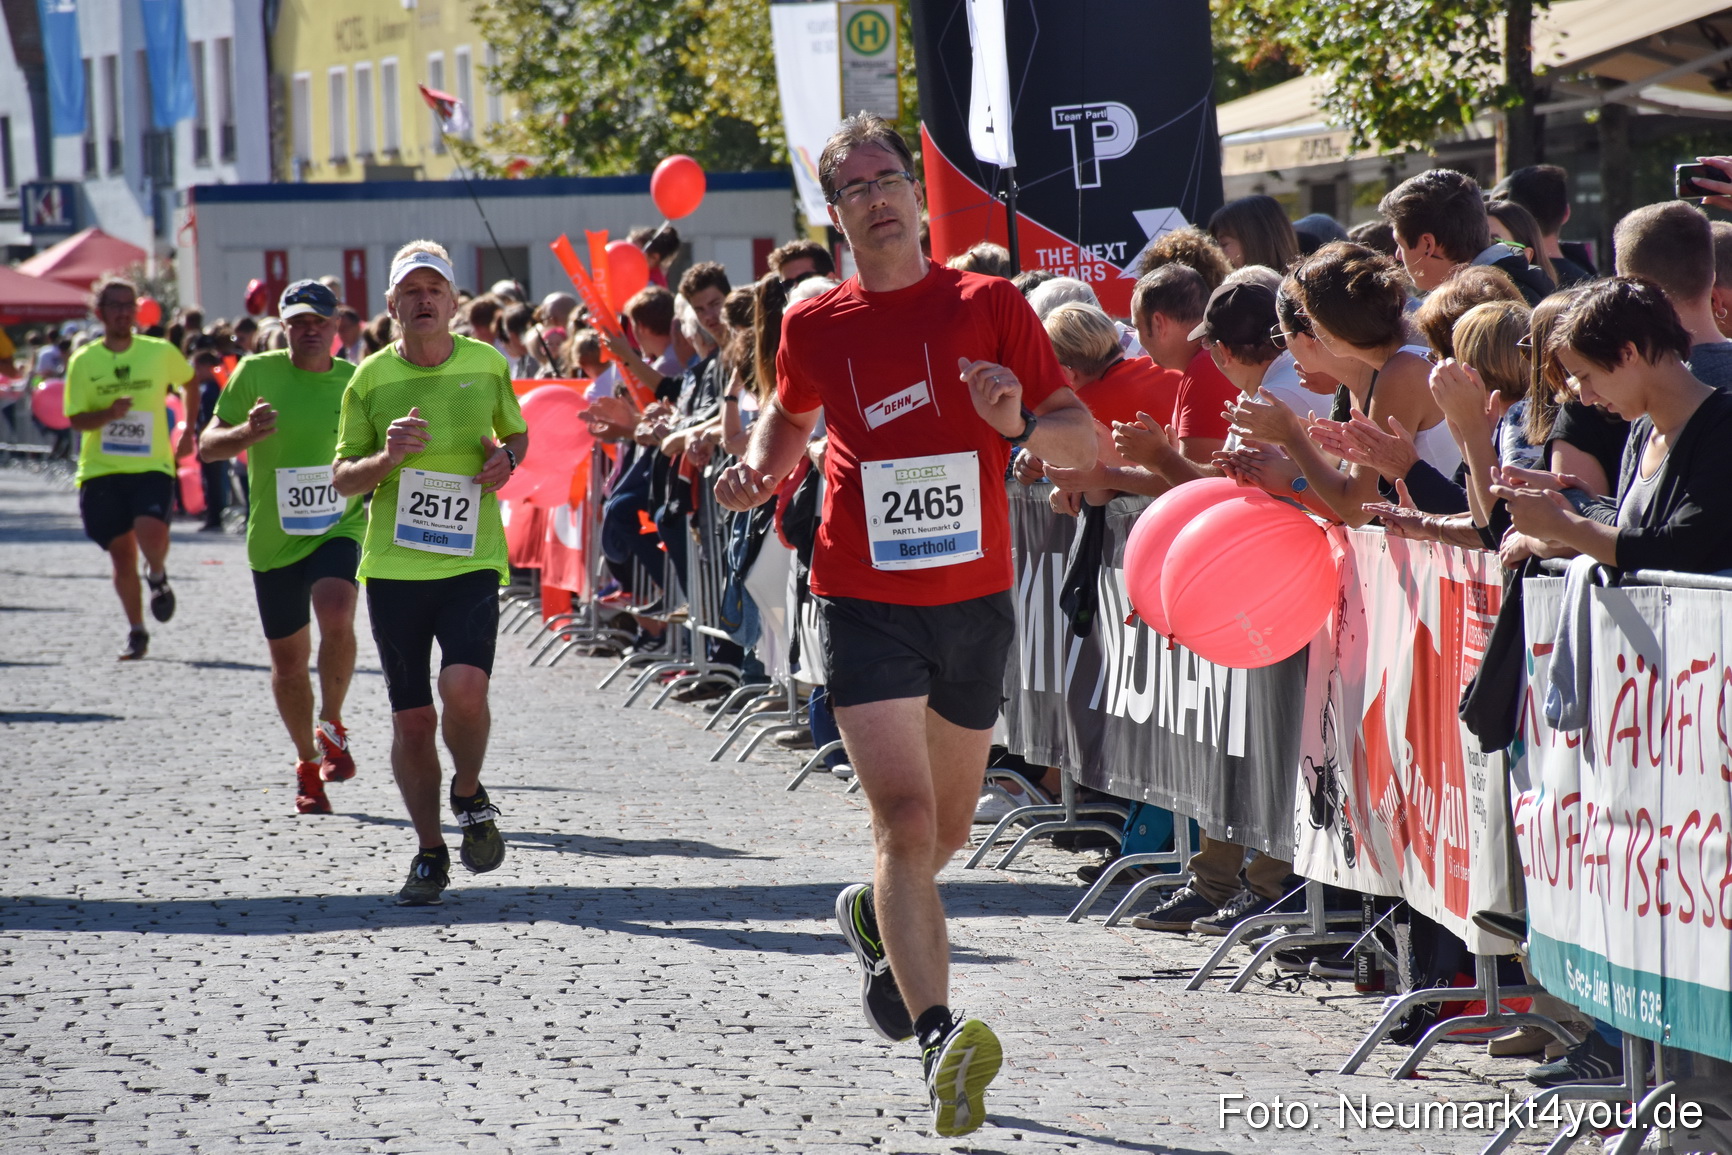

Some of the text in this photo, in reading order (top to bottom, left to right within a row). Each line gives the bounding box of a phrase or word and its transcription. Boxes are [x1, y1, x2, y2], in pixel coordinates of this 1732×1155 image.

[857, 20, 878, 45] H
[1036, 241, 1127, 267] THE NEXT
[884, 394, 912, 416] DEHN
[109, 422, 146, 438] 2296
[895, 464, 947, 481] BOCK
[424, 477, 462, 491] BOCK
[288, 484, 338, 508] 3070
[409, 491, 470, 522] 2512
[882, 484, 964, 524] 2465
[413, 518, 456, 530] PARTL Neumarkt
[892, 524, 951, 536] PARTL Neumarkt
[422, 531, 449, 545] Erich
[899, 537, 956, 557] Berthold
[1358, 955, 1368, 977] now
